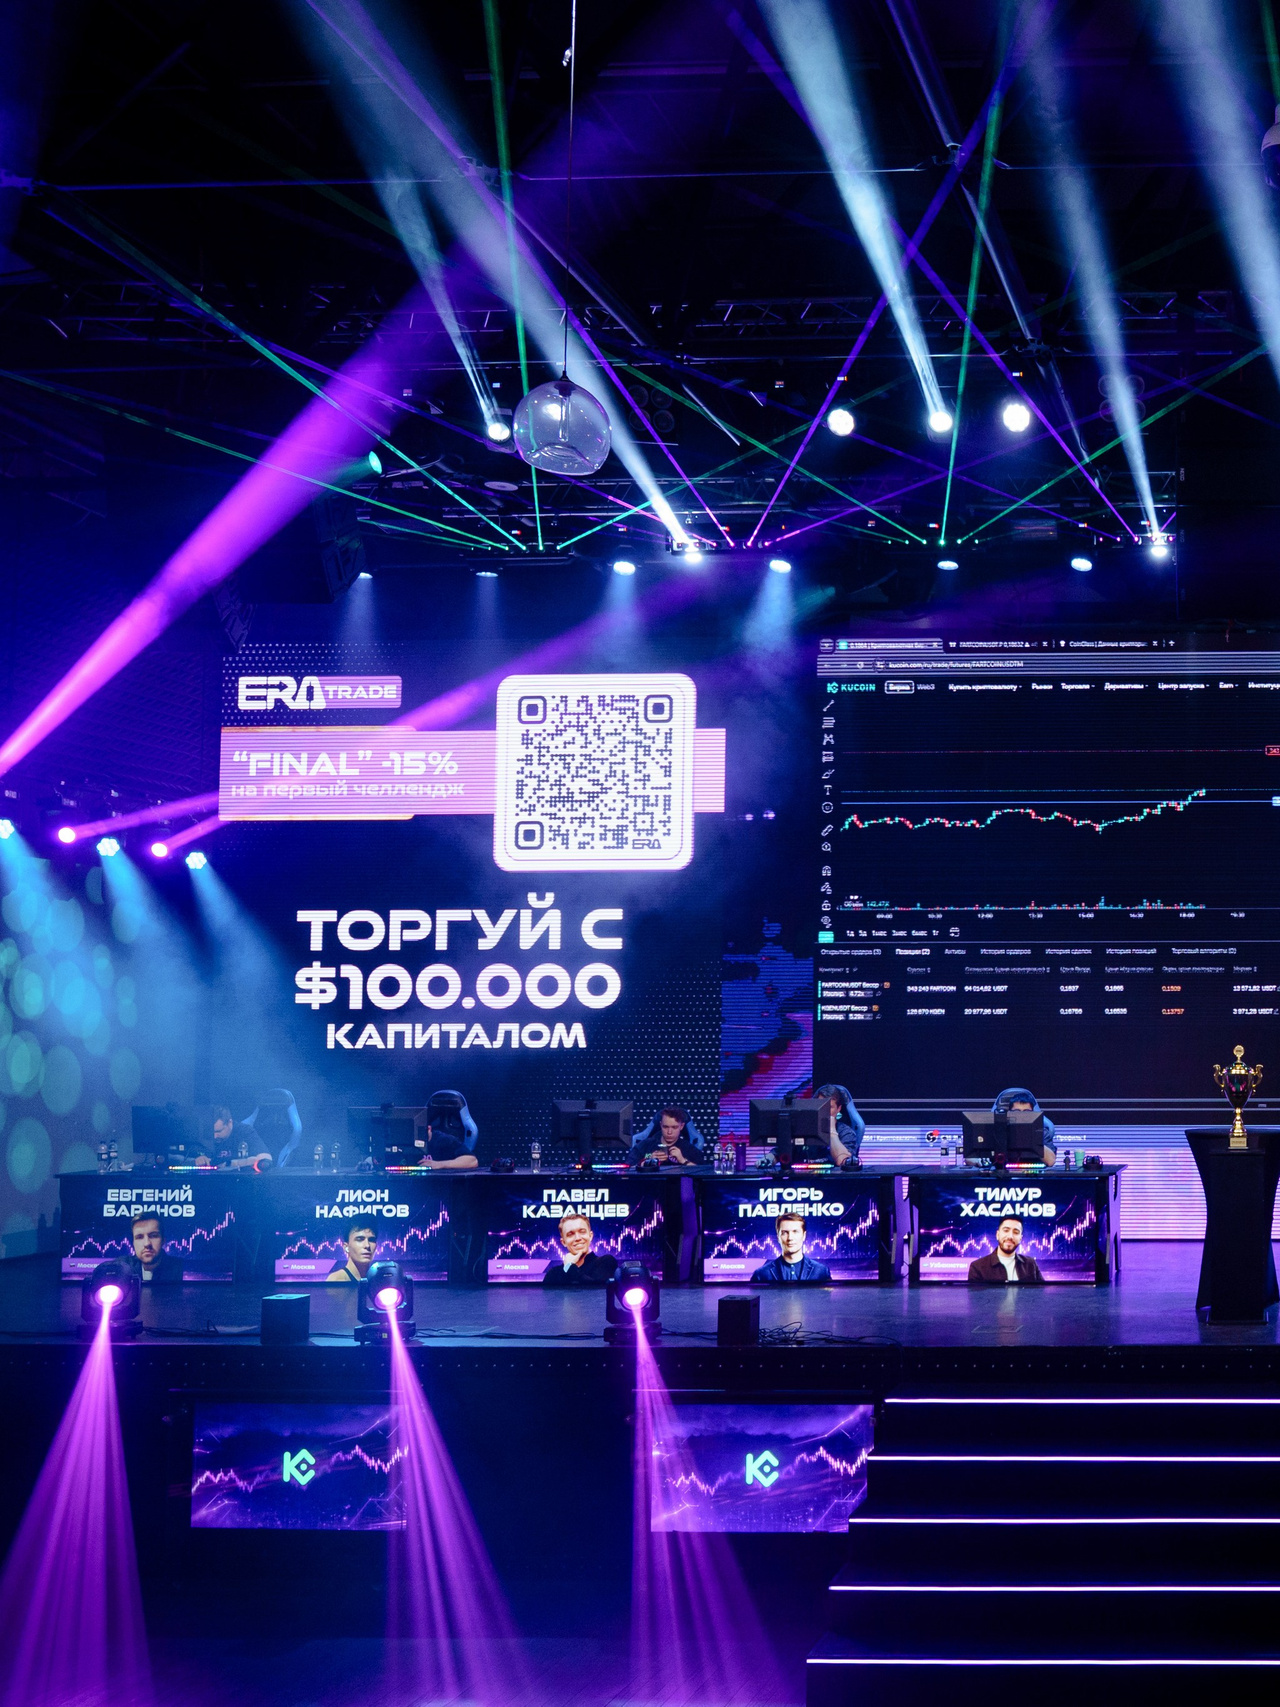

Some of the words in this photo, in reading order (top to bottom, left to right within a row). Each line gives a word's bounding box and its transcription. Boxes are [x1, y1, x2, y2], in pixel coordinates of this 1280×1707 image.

[238, 676, 326, 709] ERA
[325, 685, 397, 699] TRADE
[231, 785, 257, 797] на
[263, 780, 348, 800] первый
[354, 784, 465, 798] челлендж
[632, 839, 662, 849] ERA
[297, 892, 562, 951] ТОРГУЙ
[581, 908, 624, 950] С
[295, 961, 622, 1010] $100.000
[327, 1022, 587, 1049] КАПИТАЛОМ
[107, 1184, 193, 1202] ЕВГЕНИЙ
[336, 1189, 389, 1203] ЛИОН
[543, 1188, 609, 1203] ПАВЕЛ
[759, 1187, 824, 1202] ИГОРЬ
[975, 1187, 1042, 1201] ТИМУР
[523, 1204, 630, 1220] КАЗАНЦЕВ
[739, 1202, 844, 1217] ПАВЛЕНКО
[960, 1203, 1056, 1217] ХАСАНОВ
